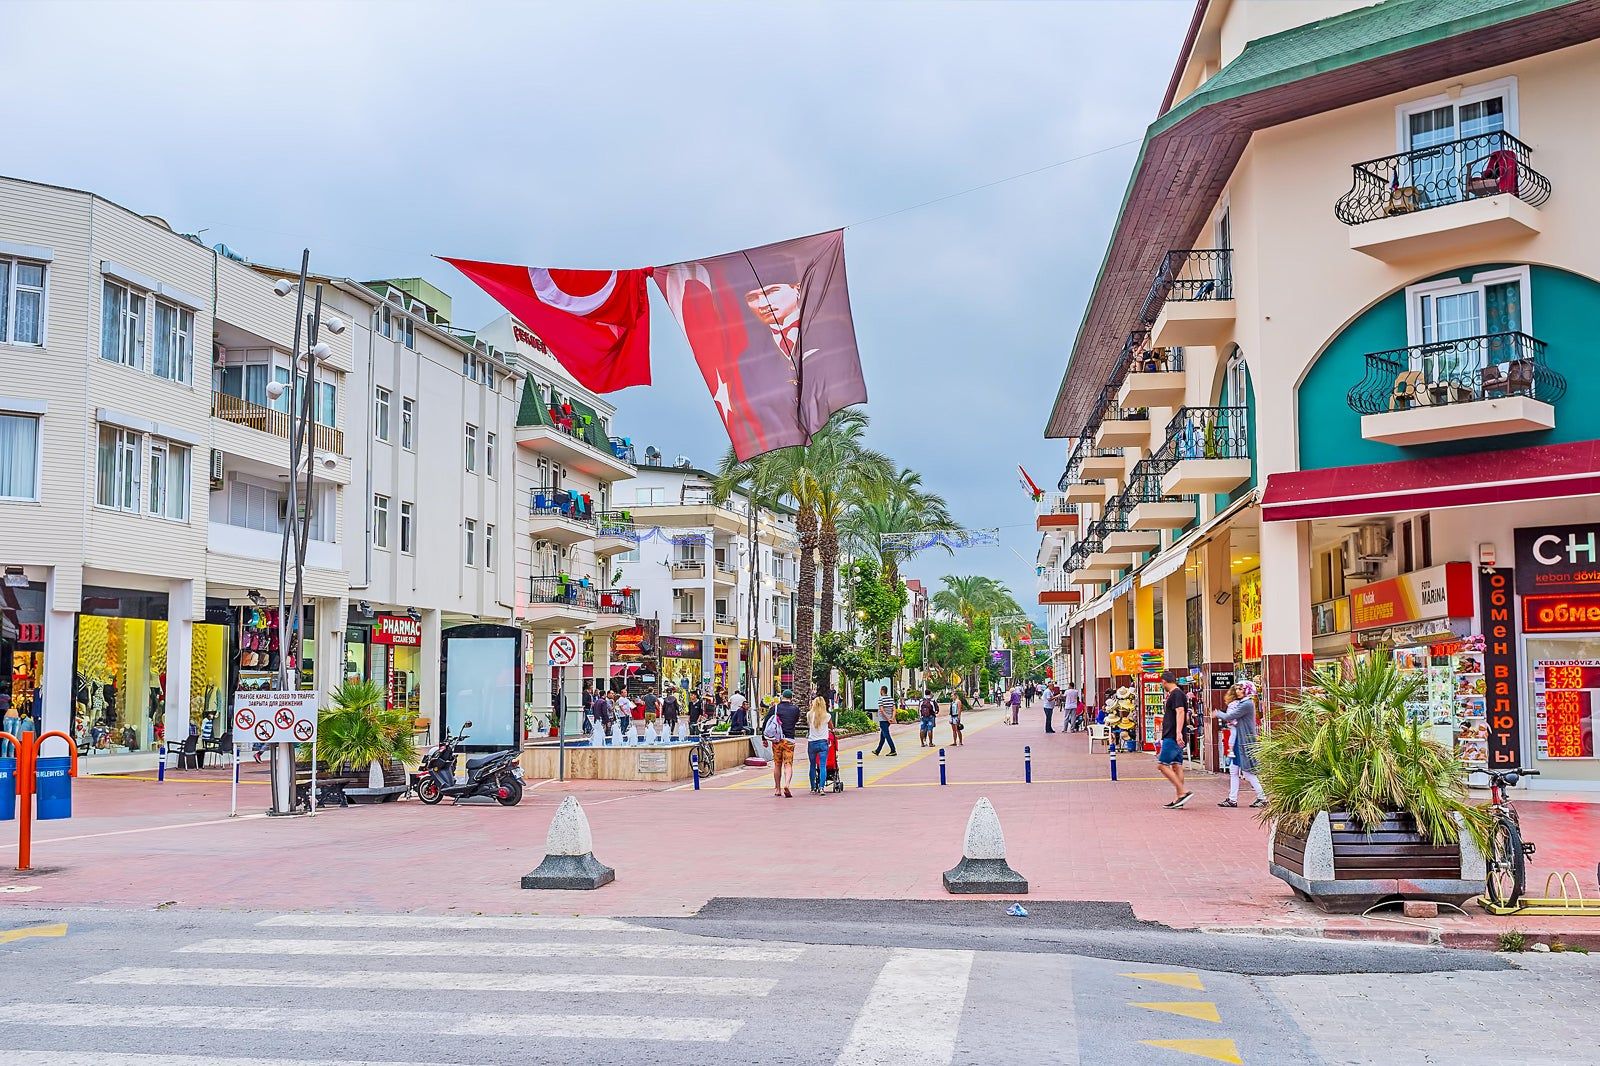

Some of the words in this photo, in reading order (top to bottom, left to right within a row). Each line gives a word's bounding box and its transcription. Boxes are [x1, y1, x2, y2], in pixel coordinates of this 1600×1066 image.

[1536, 573, 1570, 583] keban
[1490, 575, 1507, 655] обмен
[1549, 667, 1582, 678] 3.450
[1549, 678, 1582, 689] 3.750
[1493, 665, 1515, 763] валюты
[1548, 735, 1581, 746] 0.395
[1549, 746, 1581, 757] 0.380
